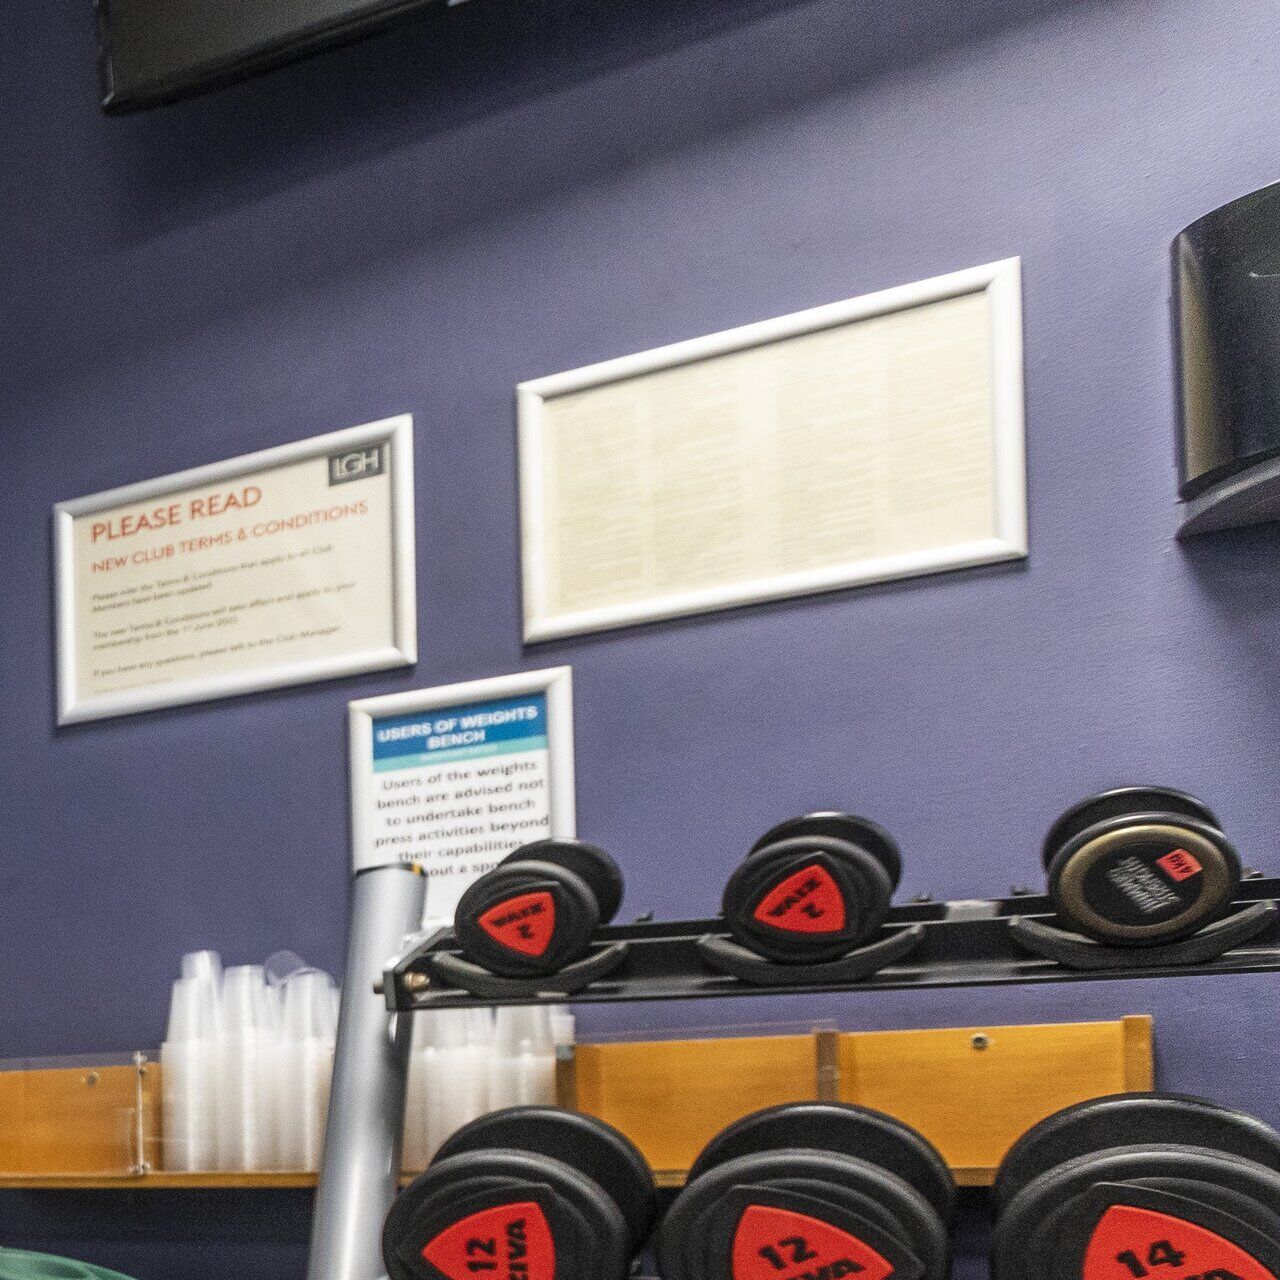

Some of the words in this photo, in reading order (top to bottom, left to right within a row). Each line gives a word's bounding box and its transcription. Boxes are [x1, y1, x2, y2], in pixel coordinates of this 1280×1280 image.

[92, 503, 182, 545] PLEASE
[189, 487, 262, 520] READ
[93, 556, 128, 573] NEW
[133, 544, 175, 565] CLUB
[180, 530, 232, 553] TERMS
[238, 527, 247, 541] &
[253, 500, 368, 537] CONDITIONS
[376, 722, 432, 743] USERS
[433, 718, 458, 734] OF
[460, 705, 539, 729] WEIGHTS
[427, 730, 486, 750] BENCH
[383, 775, 422, 791] Users
[428, 773, 441, 784] of
[447, 769, 473, 782] the
[478, 760, 538, 777] weights
[377, 795, 421, 809] bench
[426, 791, 449, 803] are
[454, 783, 513, 799] advised
[518, 779, 546, 792] not
[386, 816, 402, 827] to
[406, 806, 483, 824] undertake
[488, 798, 536, 815] bench
[374, 834, 413, 848] press
[418, 825, 485, 842] activities
[490, 814, 550, 833] beyond
[398, 850, 432, 862] their
[438, 840, 525, 859] capabilities
[466, 1236, 498, 1274] 12
[758, 1235, 819, 1271] 12
[1115, 1239, 1187, 1279] 14
